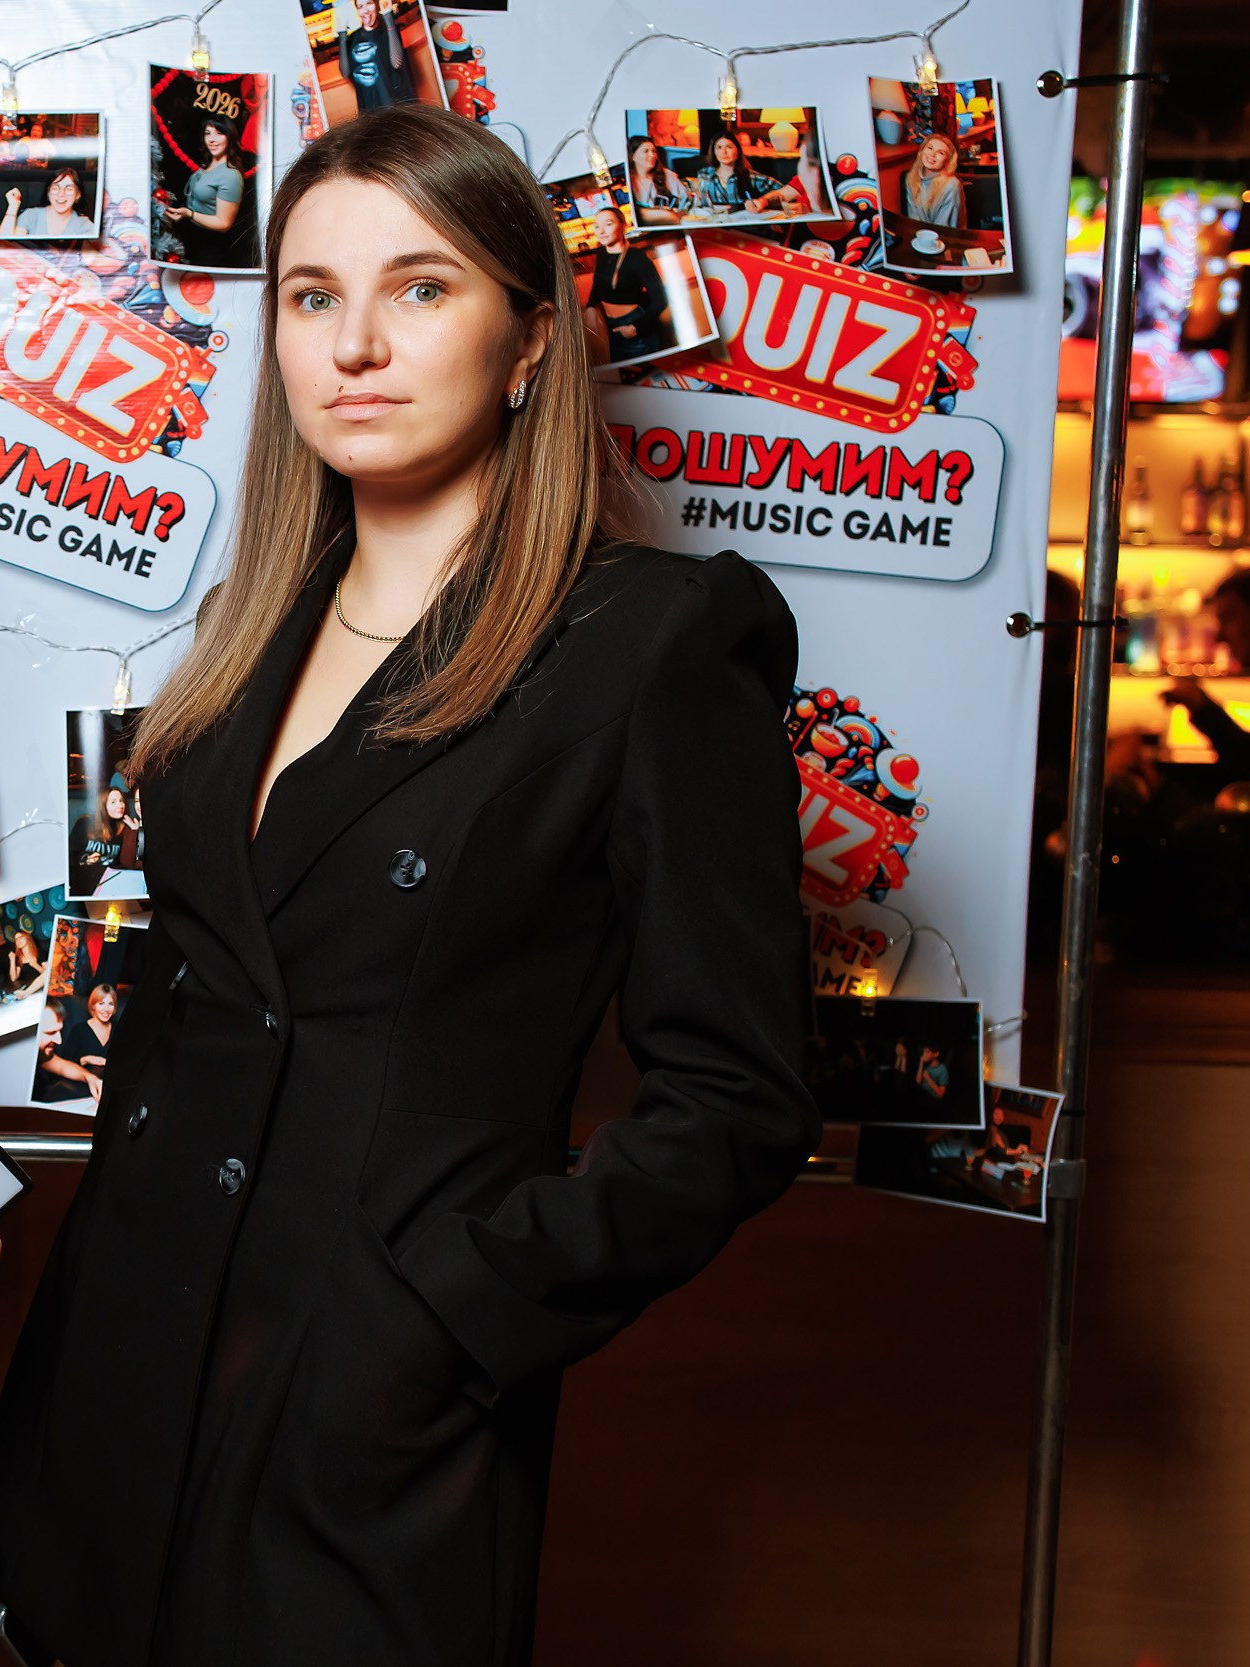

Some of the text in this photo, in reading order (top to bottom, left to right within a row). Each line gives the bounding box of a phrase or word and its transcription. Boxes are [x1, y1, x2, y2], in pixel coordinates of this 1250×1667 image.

[193, 83, 241, 119] 2026
[681, 496, 953, 547] #MUSIC GAME
[58, 525, 157, 578] GAME
